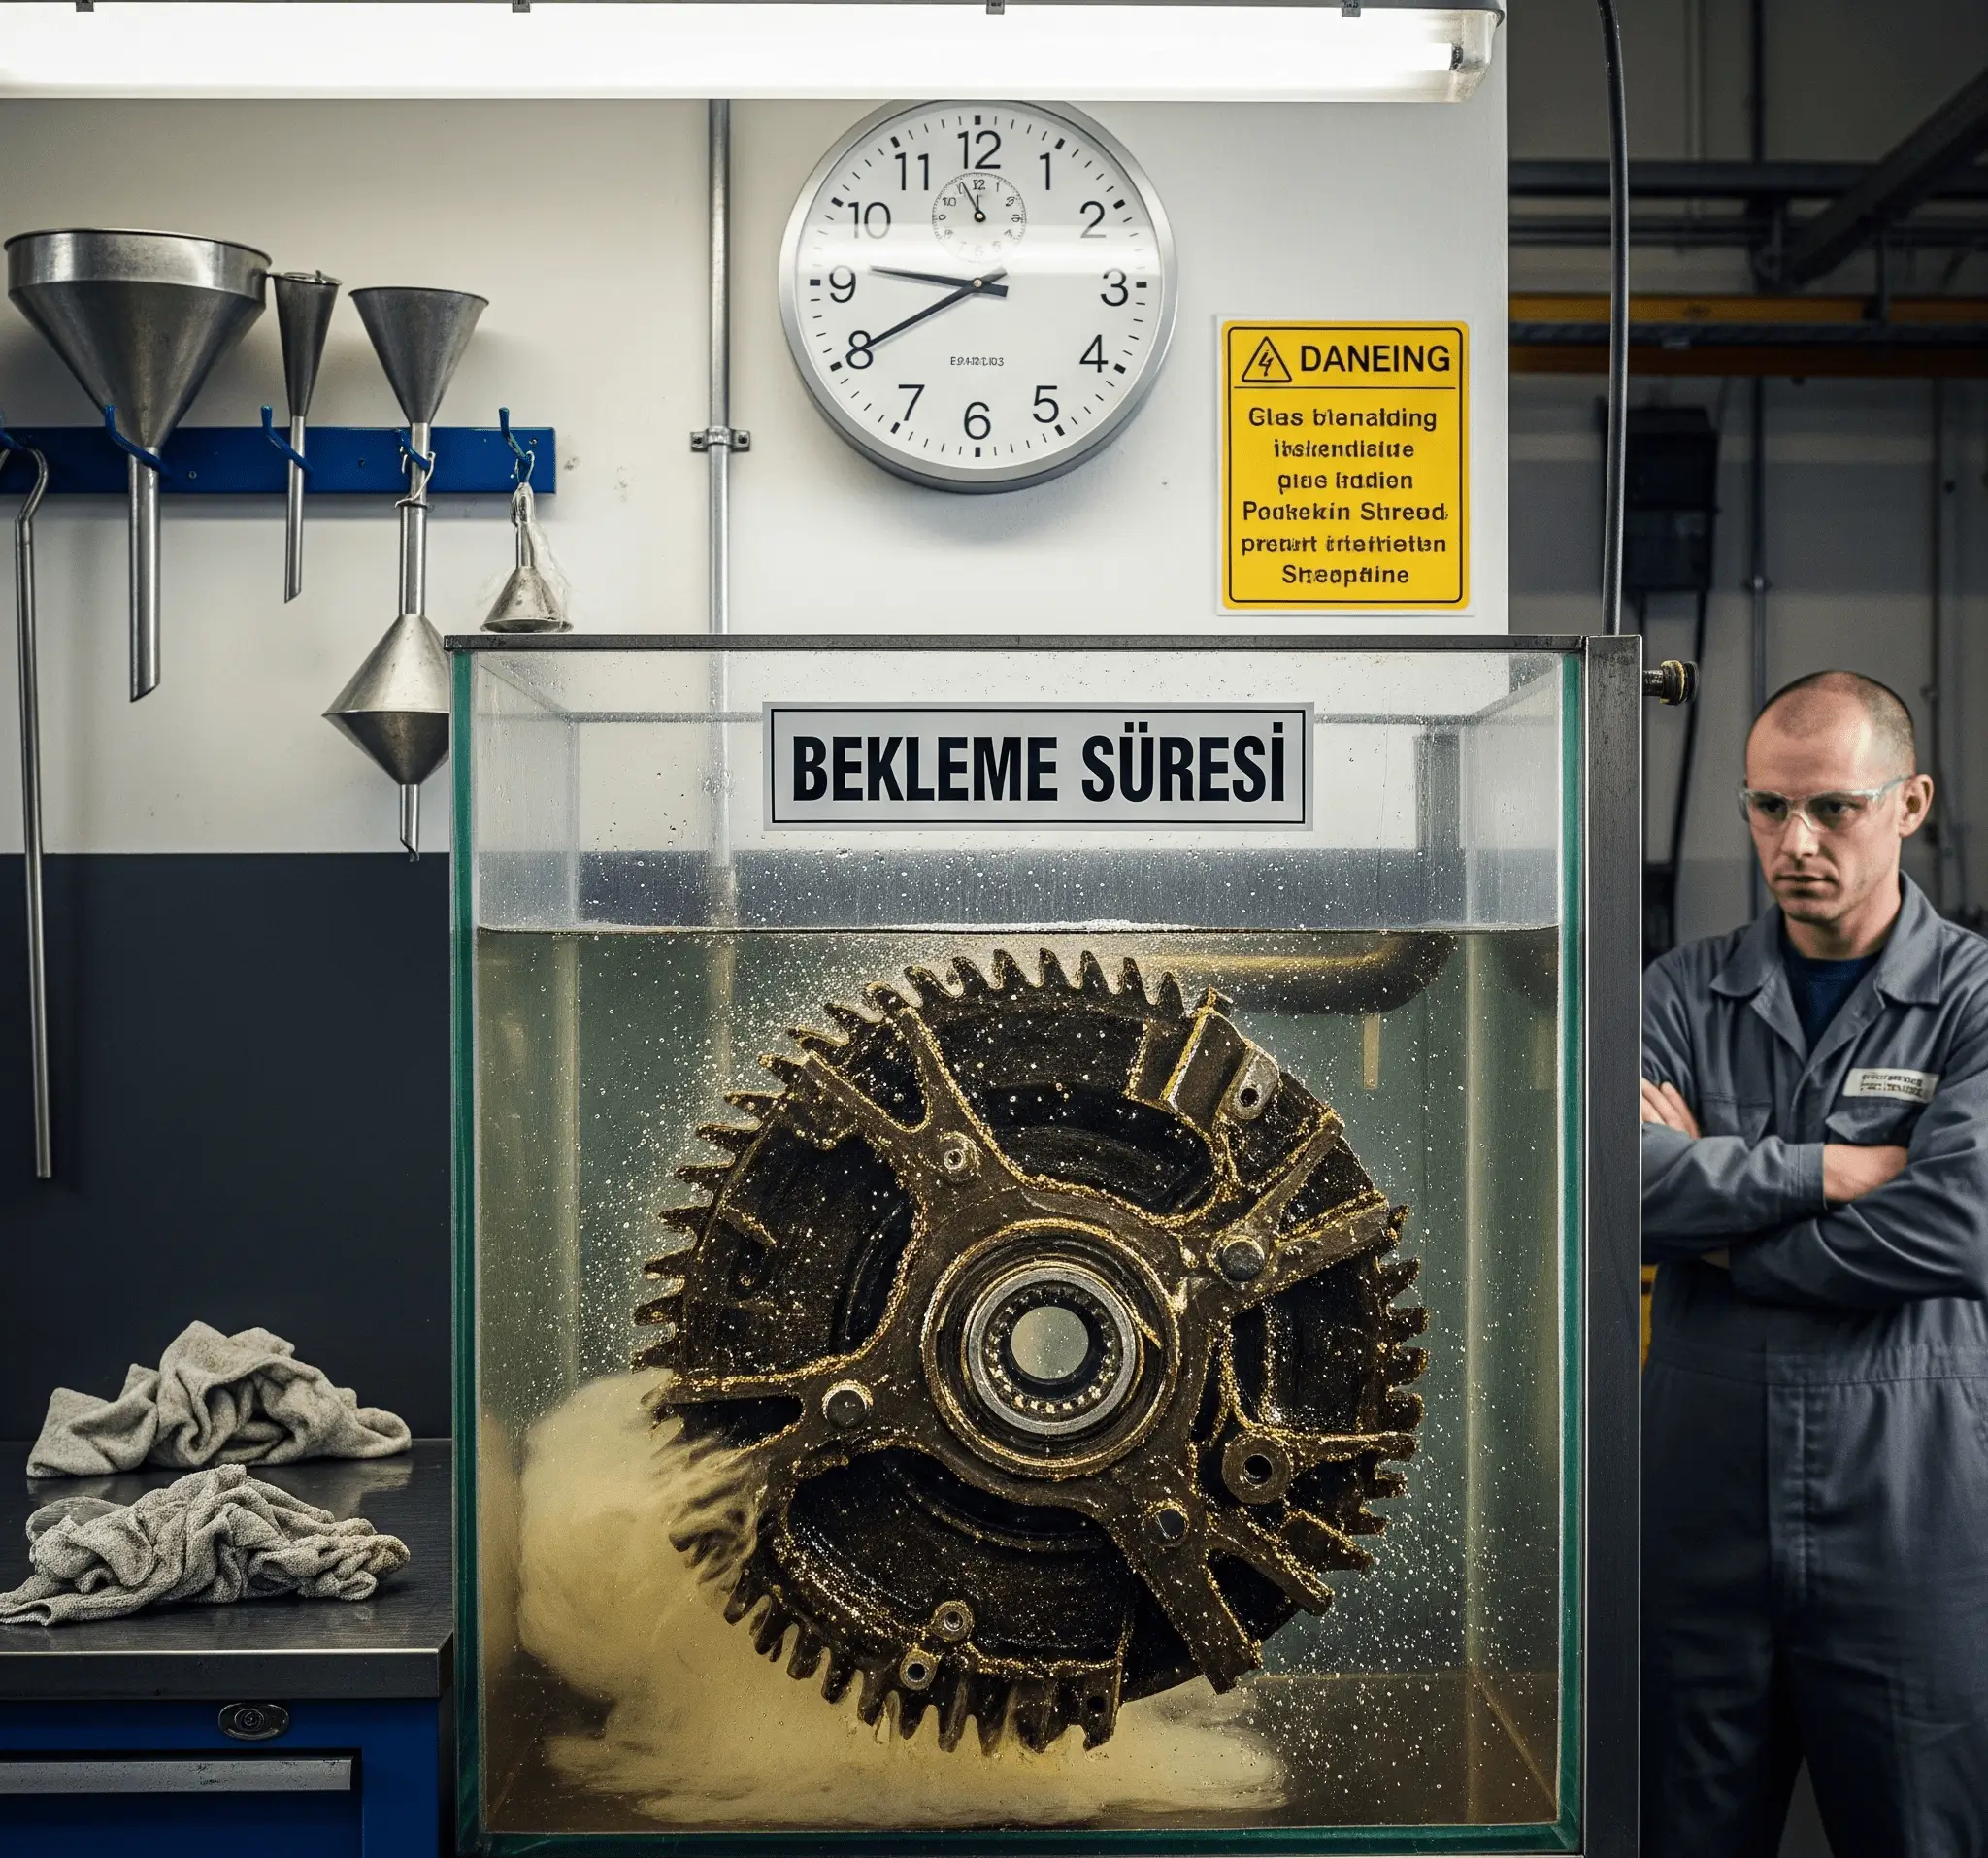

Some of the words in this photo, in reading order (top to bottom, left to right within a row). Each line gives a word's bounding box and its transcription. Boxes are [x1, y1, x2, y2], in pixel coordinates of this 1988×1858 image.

[958, 131, 1001, 169] 12
[895, 152, 929, 190] 11
[1040, 153, 1050, 190] 1
[847, 201, 891, 240] 10
[1079, 200, 1107, 239] 2
[828, 265, 857, 304] 9
[1101, 269, 1129, 307] 3
[845, 330, 875, 370] 8
[1079, 335, 1109, 373] 4
[1301, 345, 1450, 373] DANEING
[898, 384, 925, 421] 7
[964, 402, 991, 440] 6
[1033, 386, 1060, 424] 5
[793, 736, 1058, 802] BEKLEME
[1081, 721, 1285, 803] SÜRESİ
